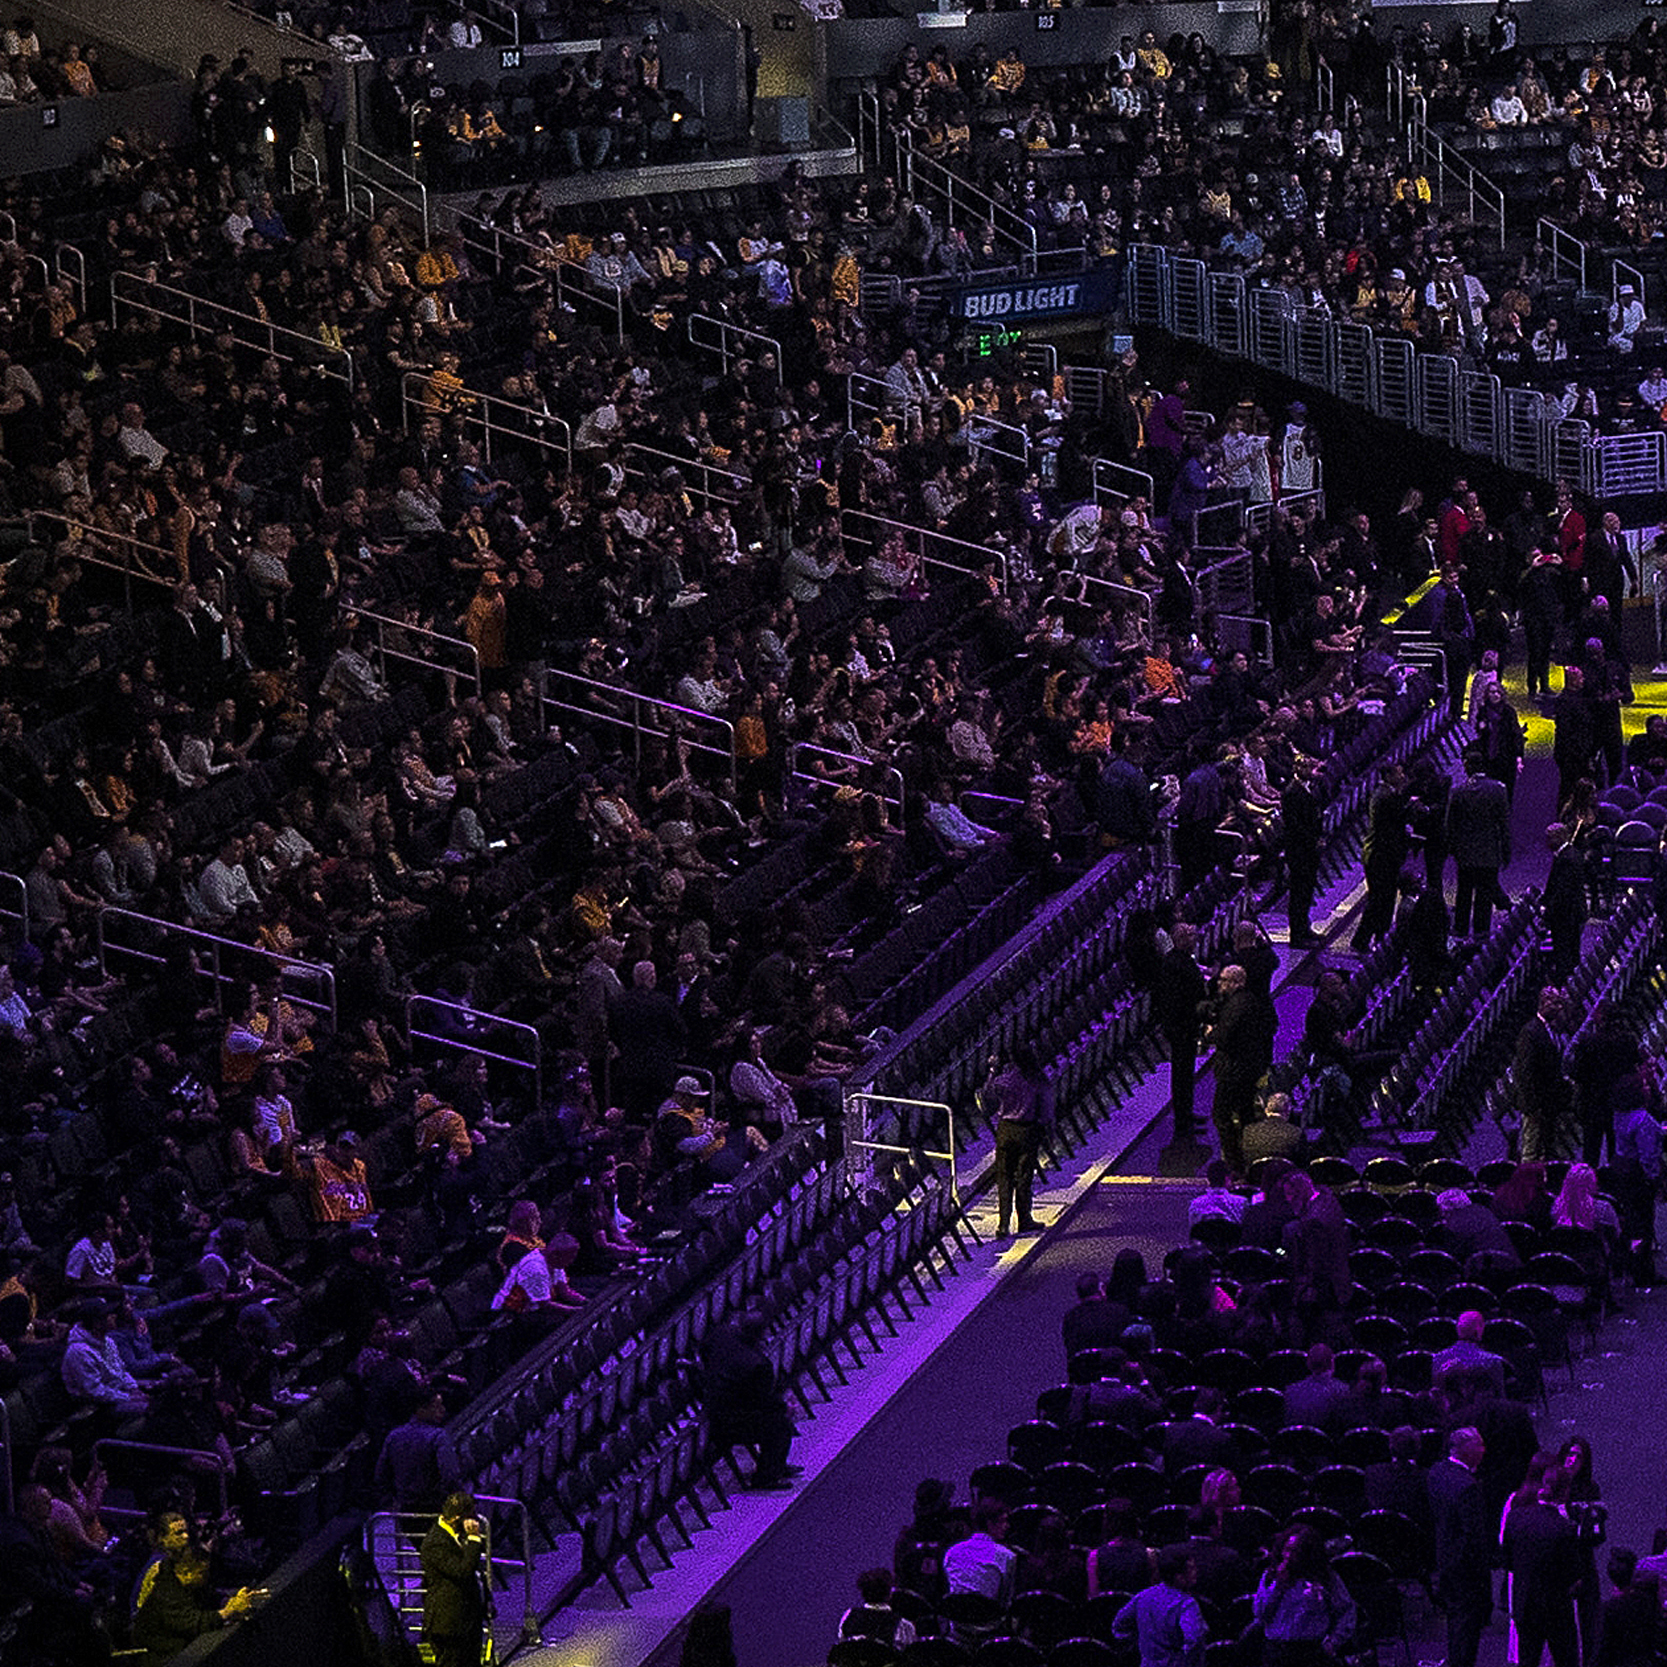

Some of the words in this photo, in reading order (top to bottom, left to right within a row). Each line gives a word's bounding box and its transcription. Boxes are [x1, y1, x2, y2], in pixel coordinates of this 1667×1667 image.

[964, 290, 1013, 318] BUD
[1015, 283, 1080, 312] LIGHT
[345, 1190, 367, 1210] 24
